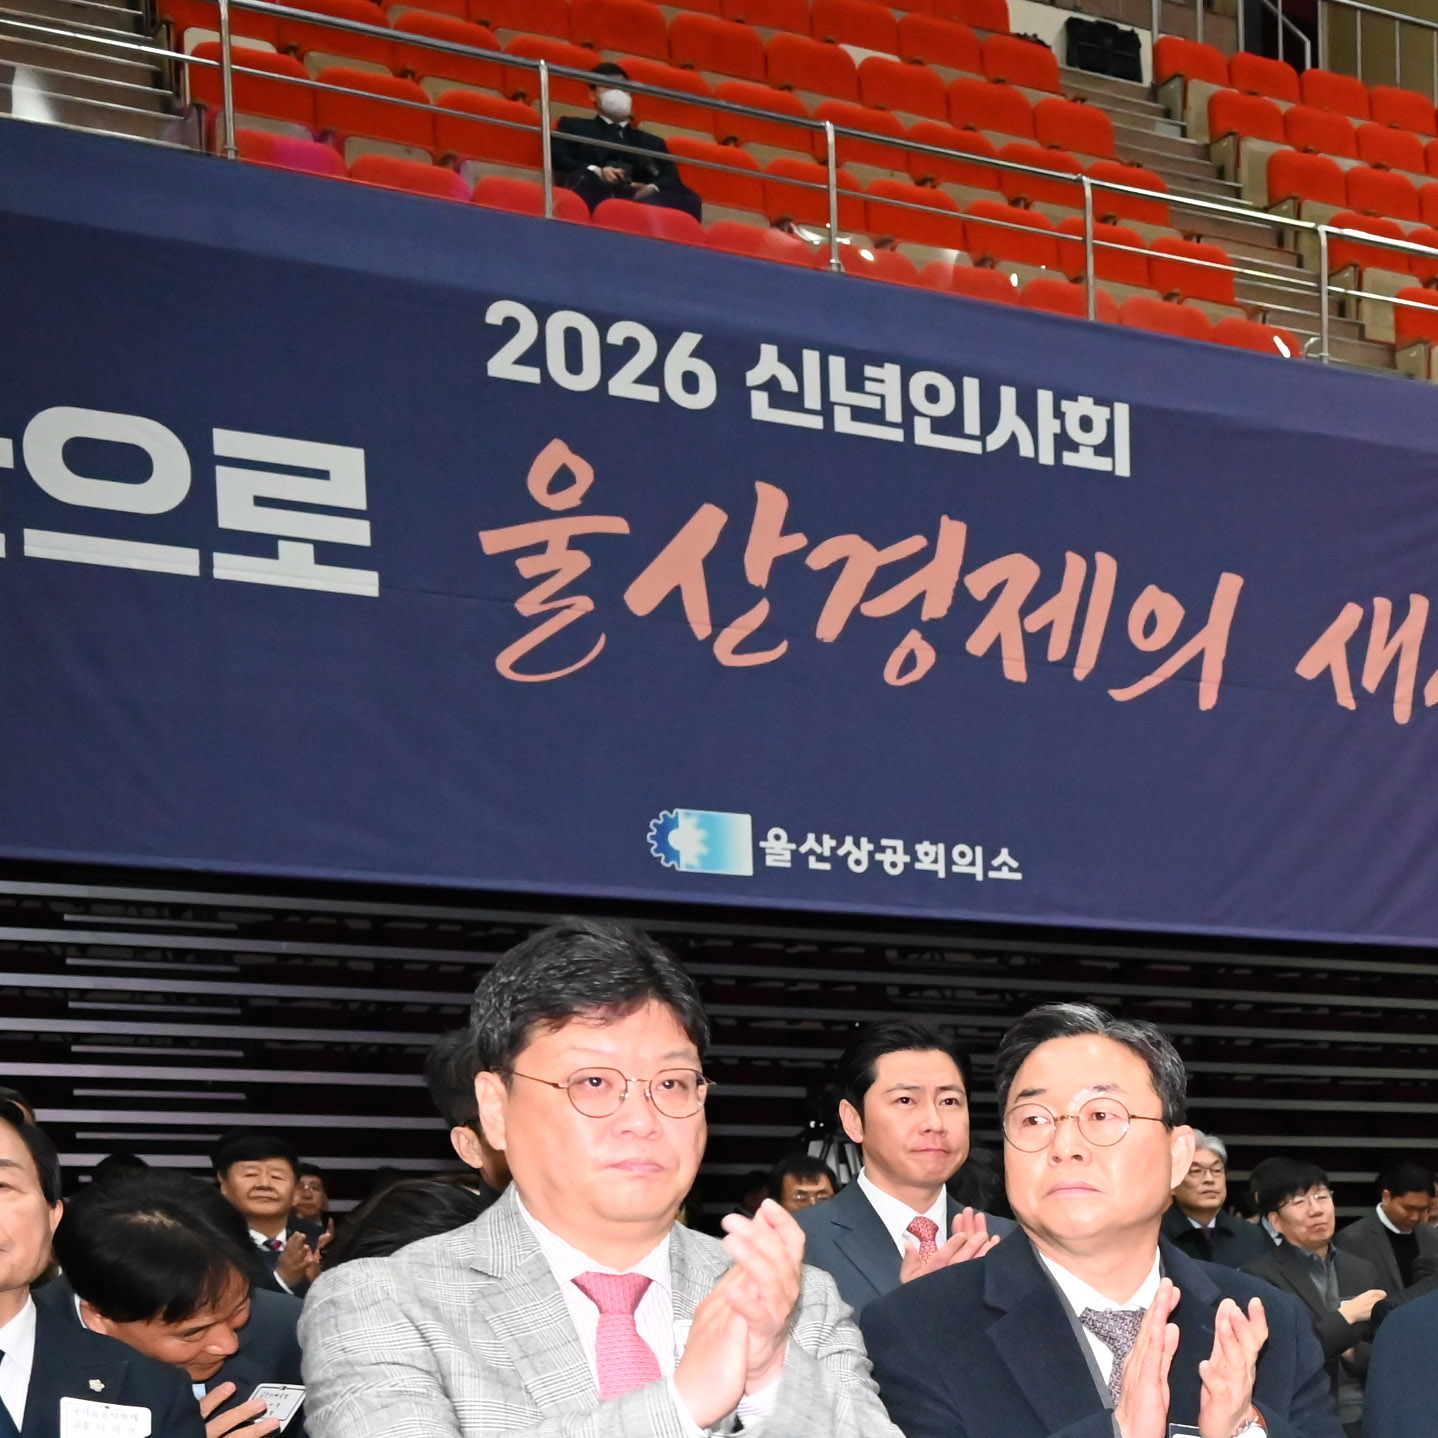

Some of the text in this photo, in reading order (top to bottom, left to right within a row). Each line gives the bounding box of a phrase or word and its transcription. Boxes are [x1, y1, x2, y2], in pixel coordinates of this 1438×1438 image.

[485, 300, 1130, 476] 2026 신년인사회
[0, 407, 379, 597] 으로
[479, 438, 1243, 710] 울산경제의
[759, 827, 1022, 881] 울산상공회의소
